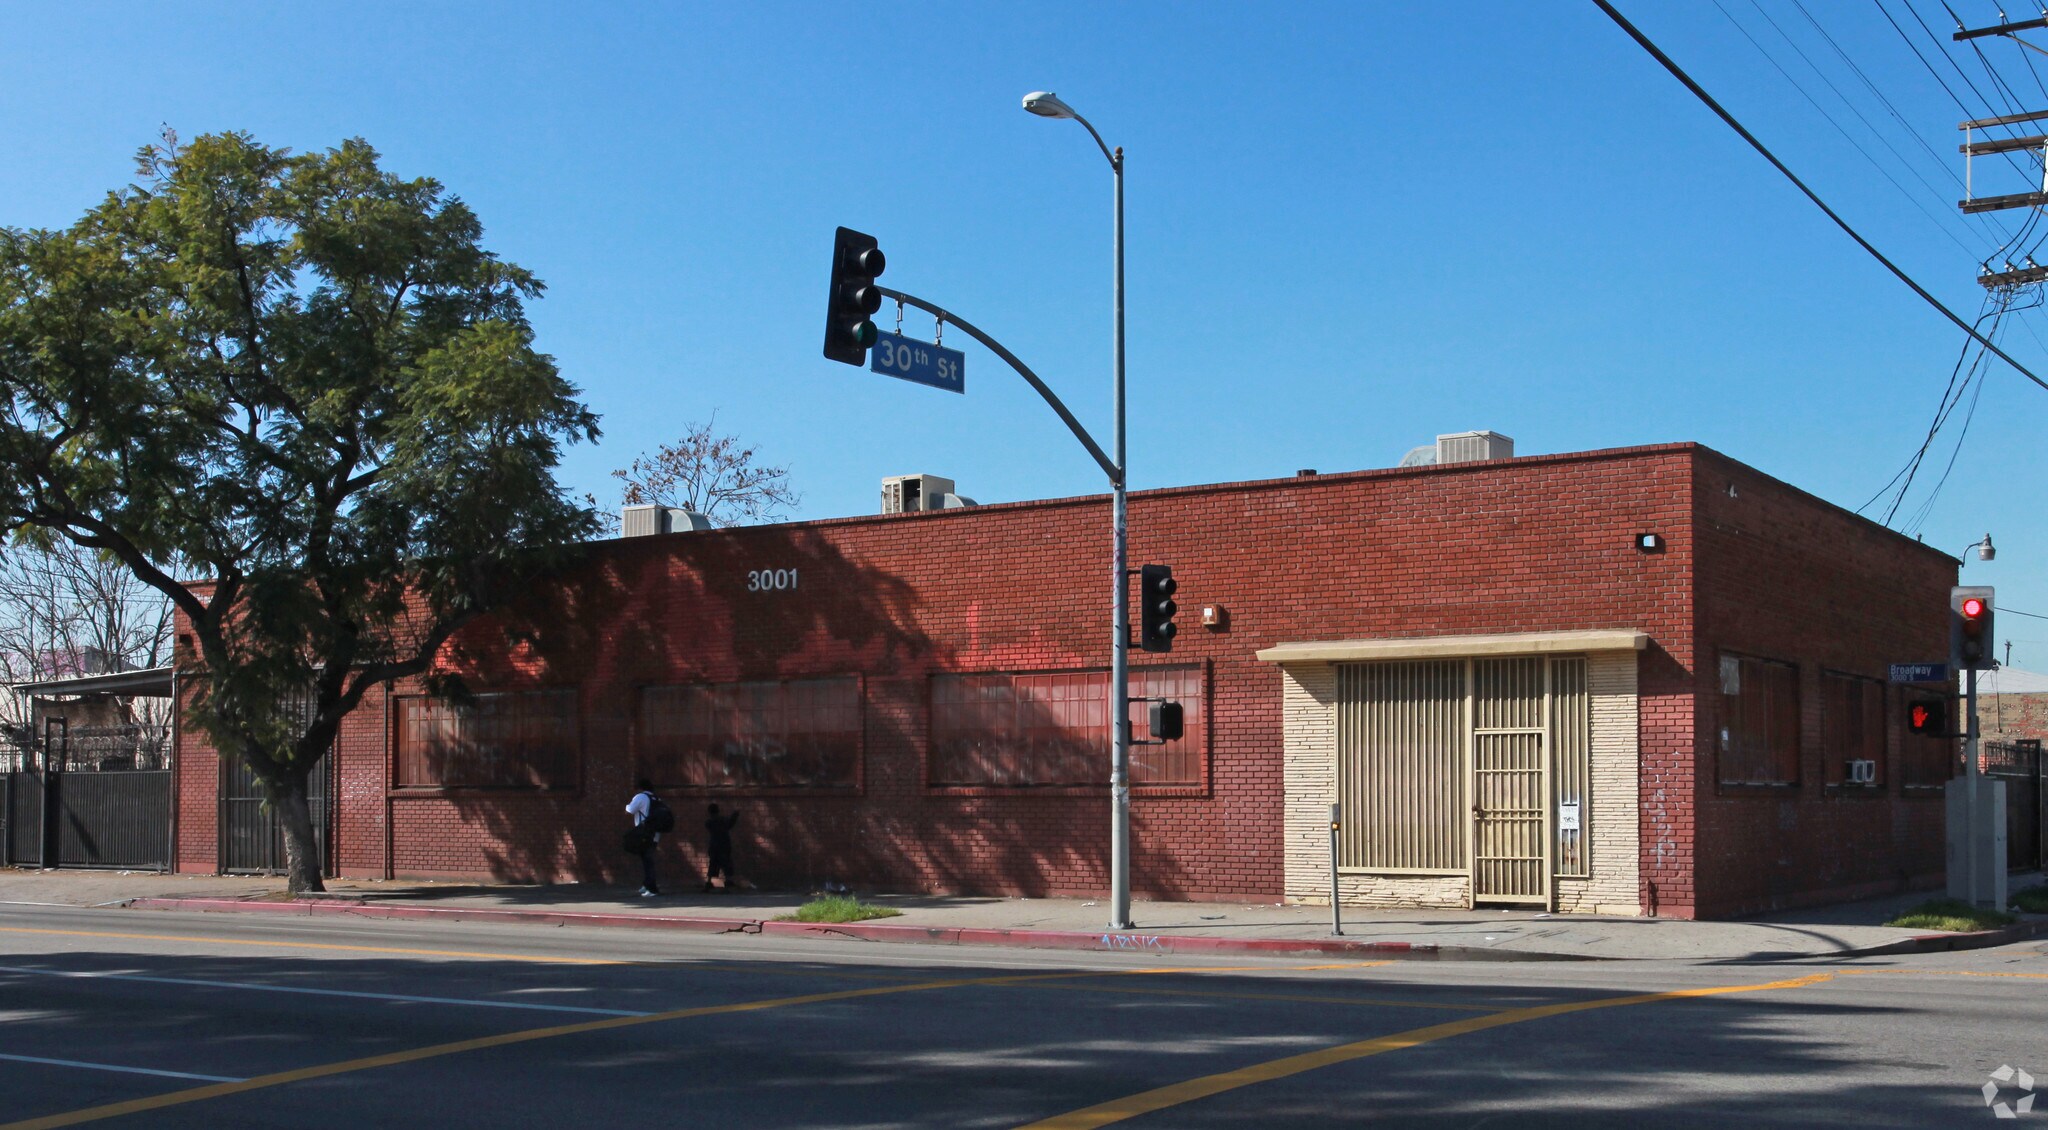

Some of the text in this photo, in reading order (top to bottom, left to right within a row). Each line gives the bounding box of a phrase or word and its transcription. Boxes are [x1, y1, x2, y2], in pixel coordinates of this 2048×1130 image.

[880, 340, 957, 381] 30th St
[747, 568, 798, 592] 3001
[1890, 664, 1932, 677] Broadway
